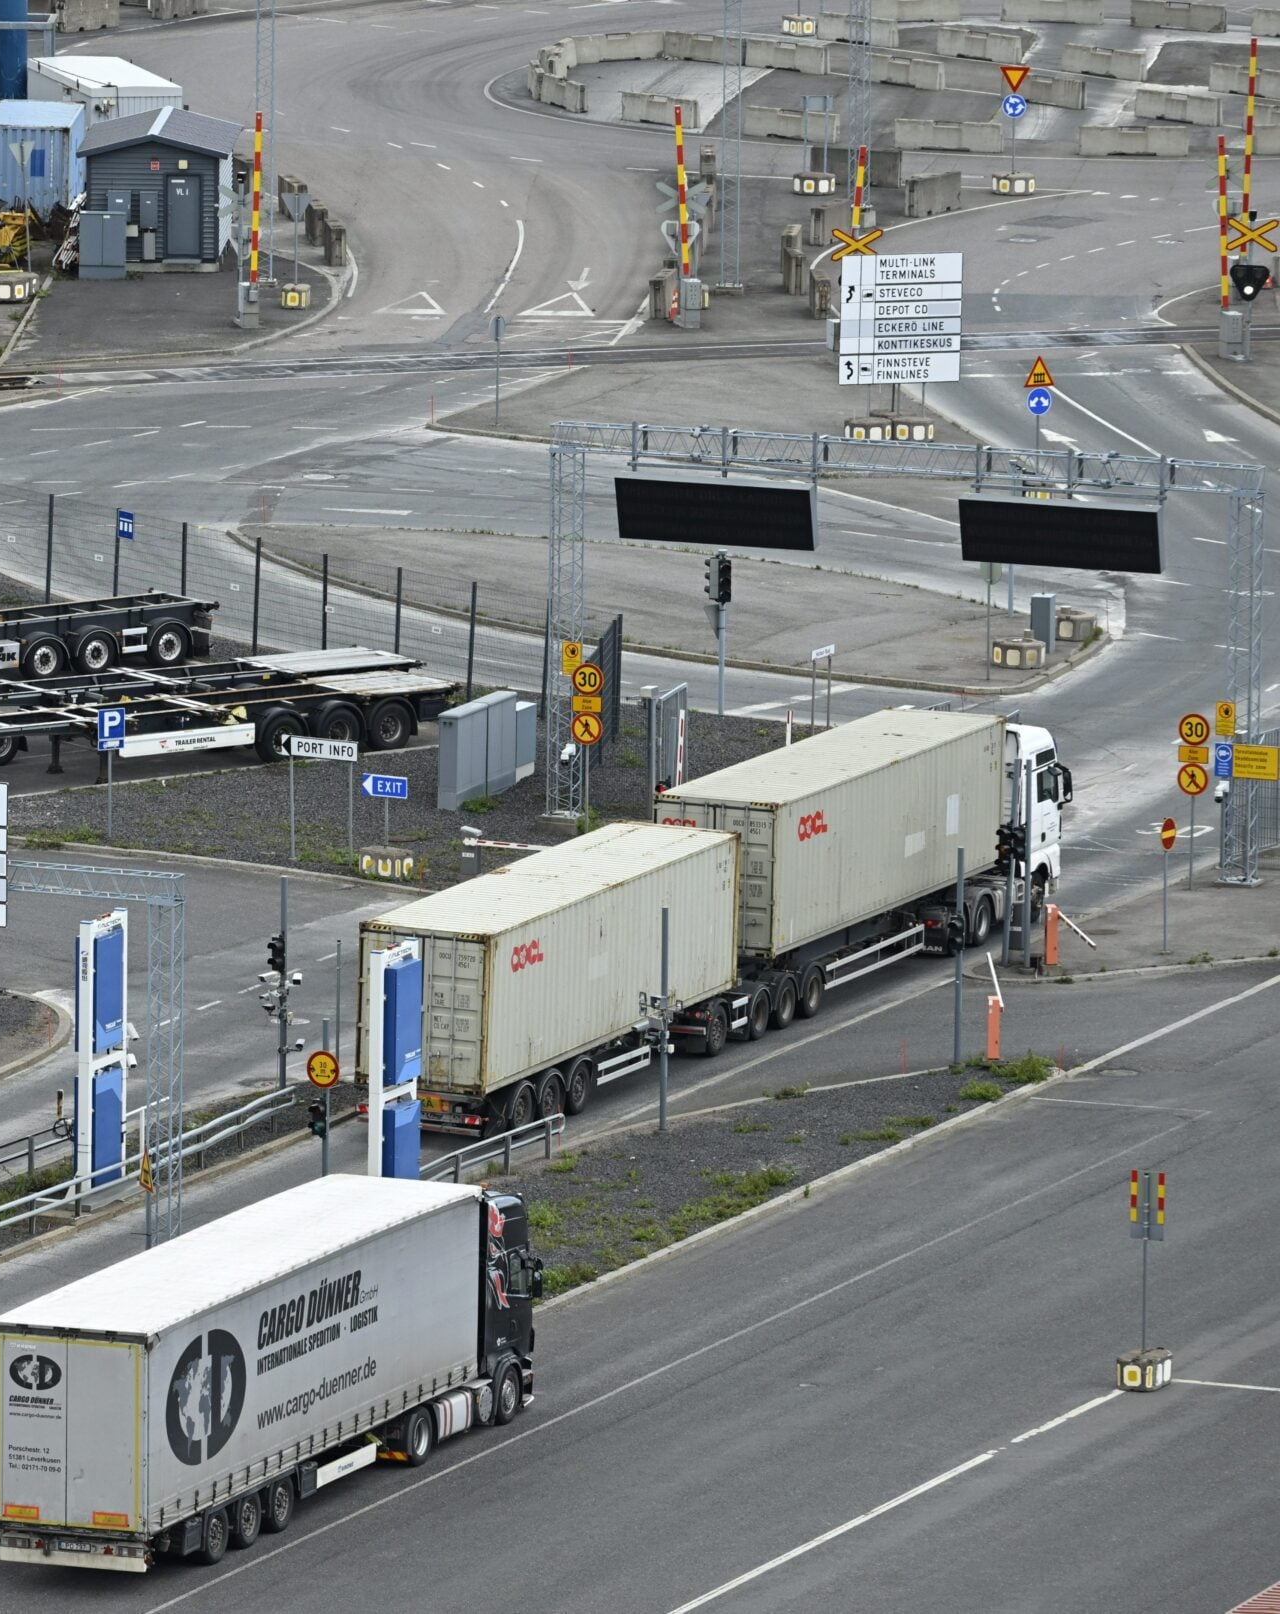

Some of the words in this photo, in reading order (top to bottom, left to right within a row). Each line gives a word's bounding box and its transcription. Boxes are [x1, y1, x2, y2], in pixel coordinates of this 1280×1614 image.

[880, 257, 935, 268] MULTI-LINK
[880, 269, 935, 280] TERMINALS
[879, 287, 923, 298] STEVECO
[878, 305, 910, 316] DEPOT
[914, 305, 928, 314] CD
[878, 322, 917, 333] ECKERÖ
[922, 321, 945, 332] LINE
[877, 338, 953, 350] KONTTIKESKUS
[877, 357, 931, 368] FINNSTEVE
[876, 369, 929, 380] FINNLINES
[578, 671, 597, 688] 30
[103, 711, 121, 737] P
[1184, 721, 1204, 738] 30
[175, 738, 196, 746] TRAILER
[197, 736, 216, 744] RENTAL
[297, 741, 324, 754] PORT
[329, 744, 354, 758] INFO
[377, 780, 403, 794] EXIT
[257, 1294, 306, 1351] CARGO
[306, 1269, 363, 1329] DÜNNER
[359, 1283, 380, 1304] GmbH
[257, 1337, 308, 1377] INTERNATIONALE
[308, 1322, 341, 1352] SPEDITION
[350, 1305, 379, 1334] LOGISTIK
[9, 1395, 30, 1403] CARGO
[257, 1356, 378, 1430] www.cargo-duenner.de
[27, 1455, 61, 1464] Leverkusen
